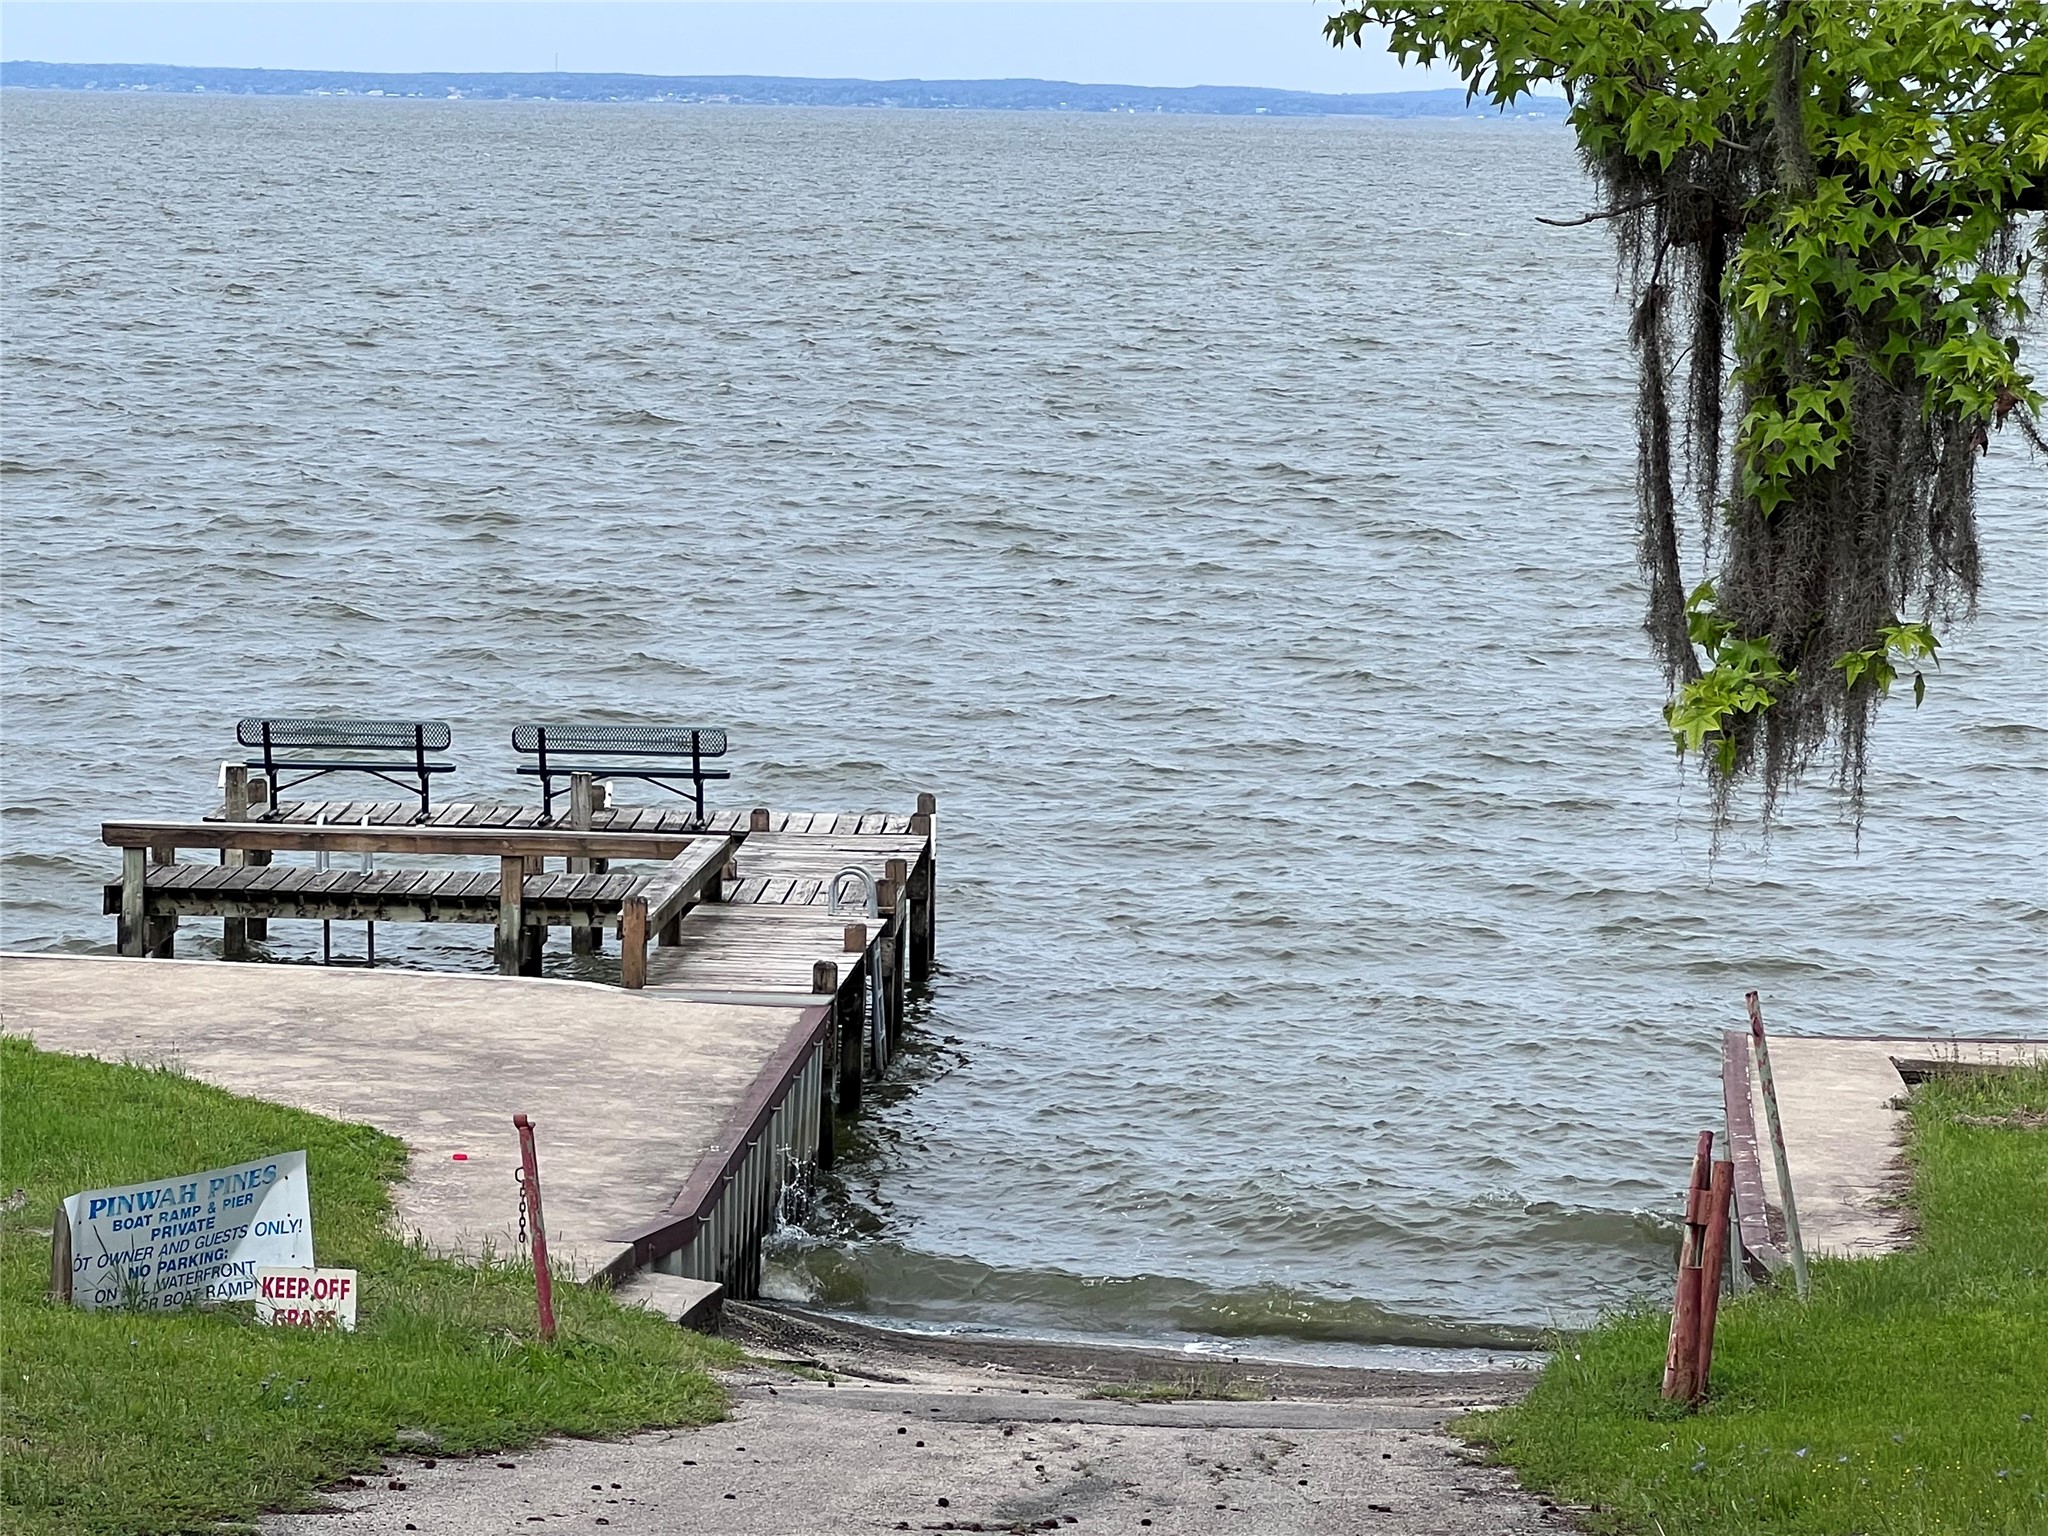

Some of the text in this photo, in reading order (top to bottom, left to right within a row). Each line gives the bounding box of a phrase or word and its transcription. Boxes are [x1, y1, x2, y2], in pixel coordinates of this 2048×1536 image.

[89, 1164, 277, 1220] PINWAH PINES
[113, 1193, 254, 1232] BOAT RAMP & PIER
[151, 1216, 216, 1242] PRIVATE
[73, 1218, 303, 1273] OT OWNER AND GUESTS ONLY!
[128, 1247, 229, 1280] NO PARKING:
[95, 1288, 118, 1304] ON
[156, 1260, 257, 1293] WATERFRONT
[261, 1276, 351, 1301] KEEP OFF
